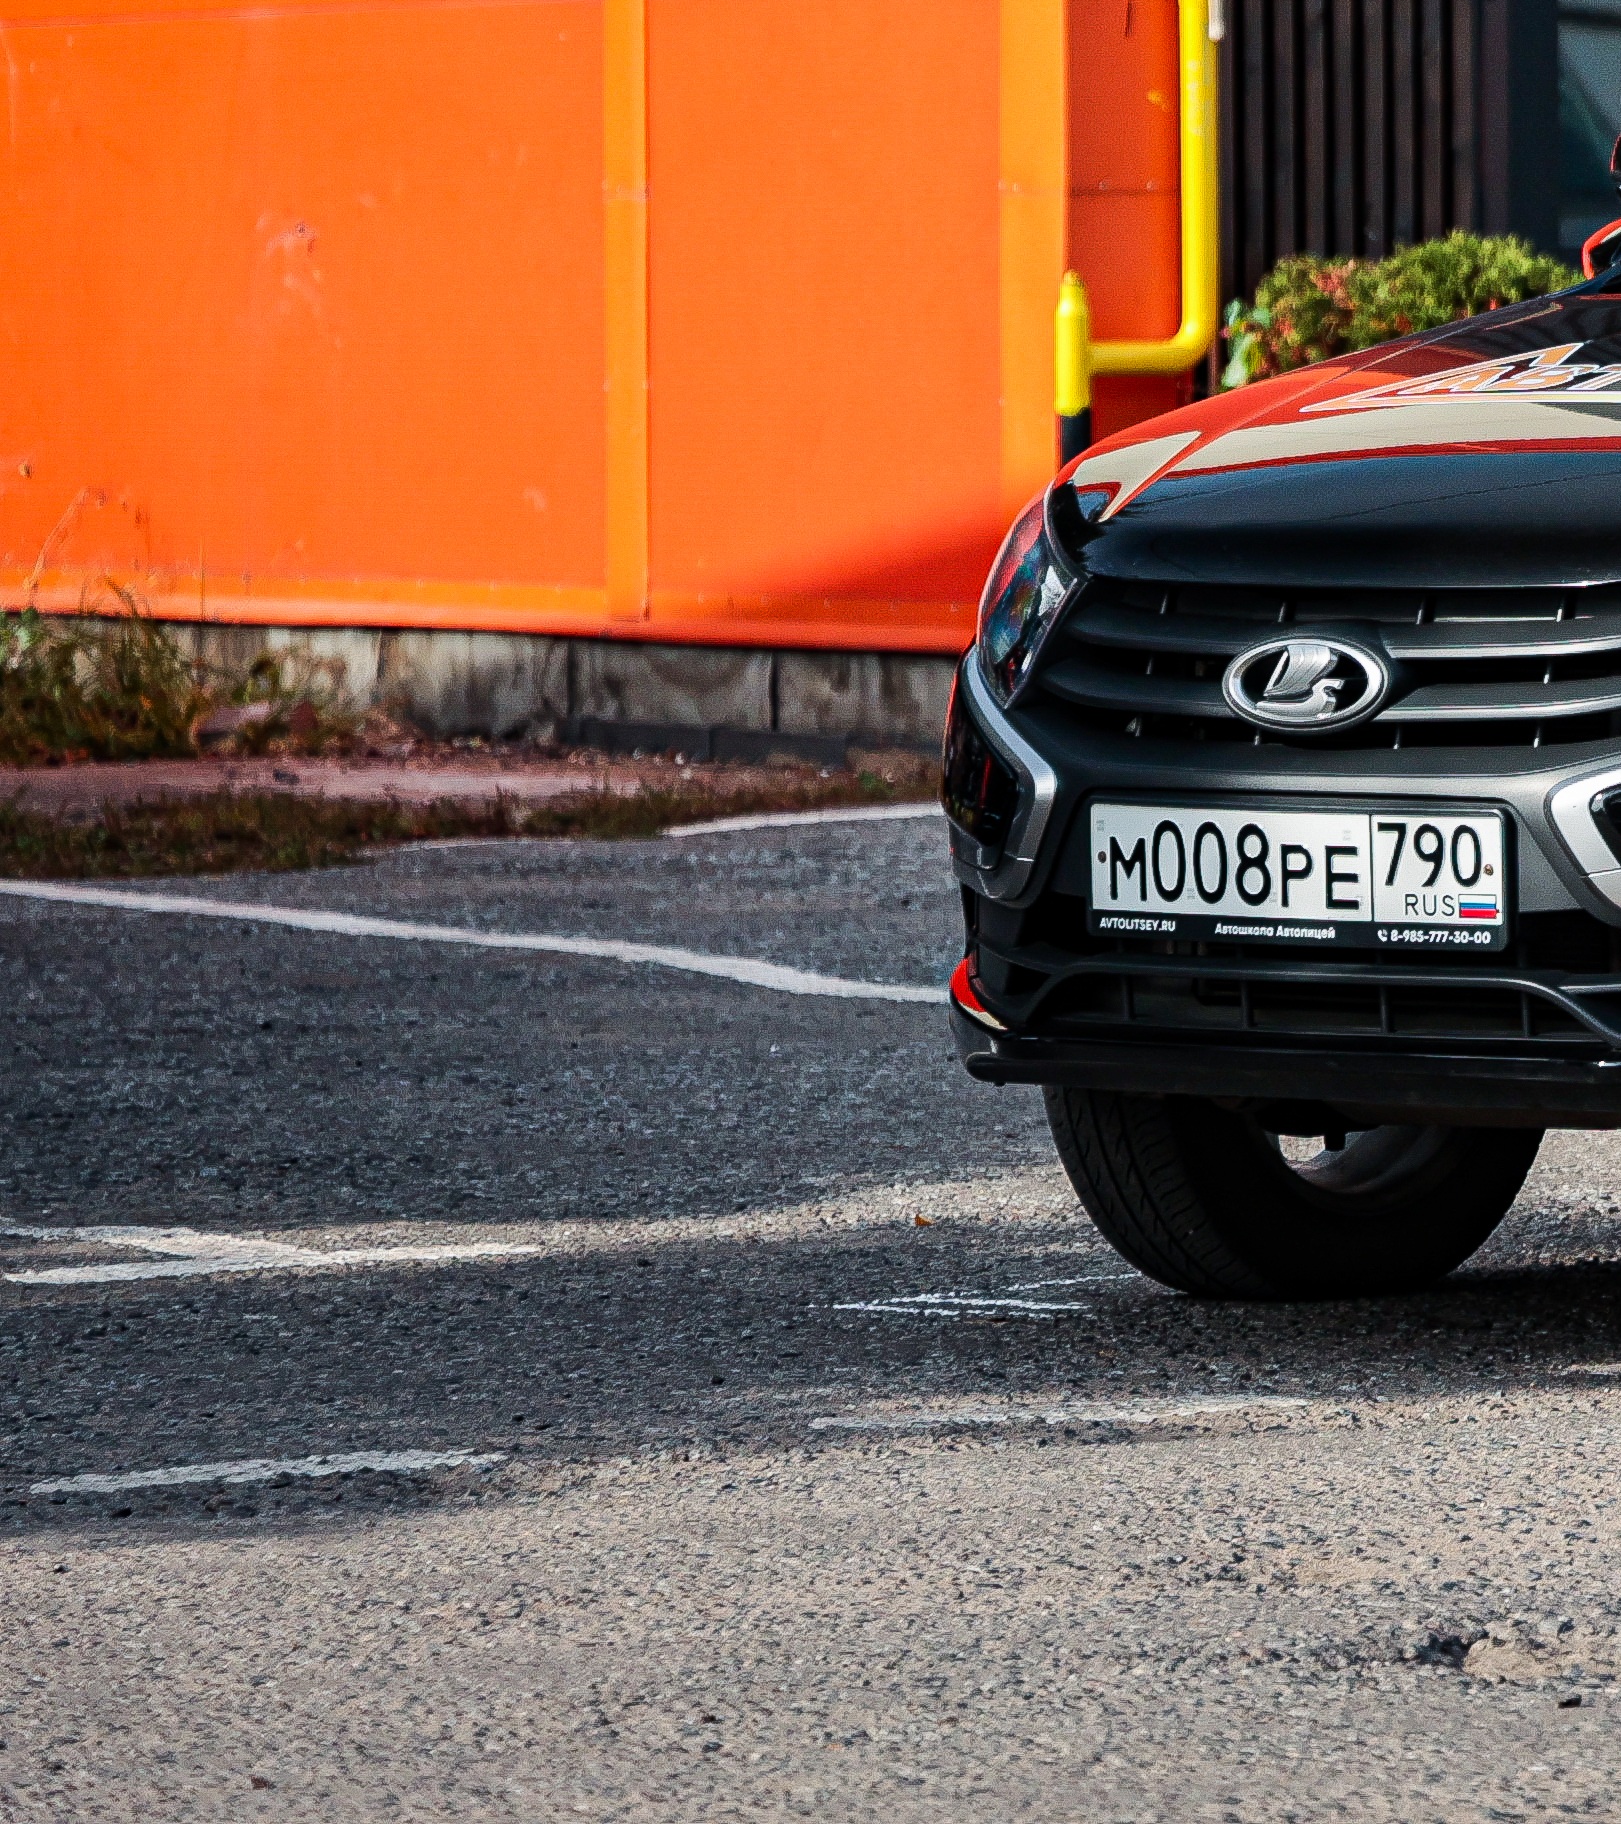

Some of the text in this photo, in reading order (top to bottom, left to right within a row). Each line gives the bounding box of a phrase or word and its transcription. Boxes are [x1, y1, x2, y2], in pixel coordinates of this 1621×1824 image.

[1376, 821, 1483, 888] 790
[1404, 893, 1456, 918] RUS
[1099, 916, 1177, 932] AVTOLITSEY.RU
[1390, 929, 1492, 945] 8-985-777-30-00
